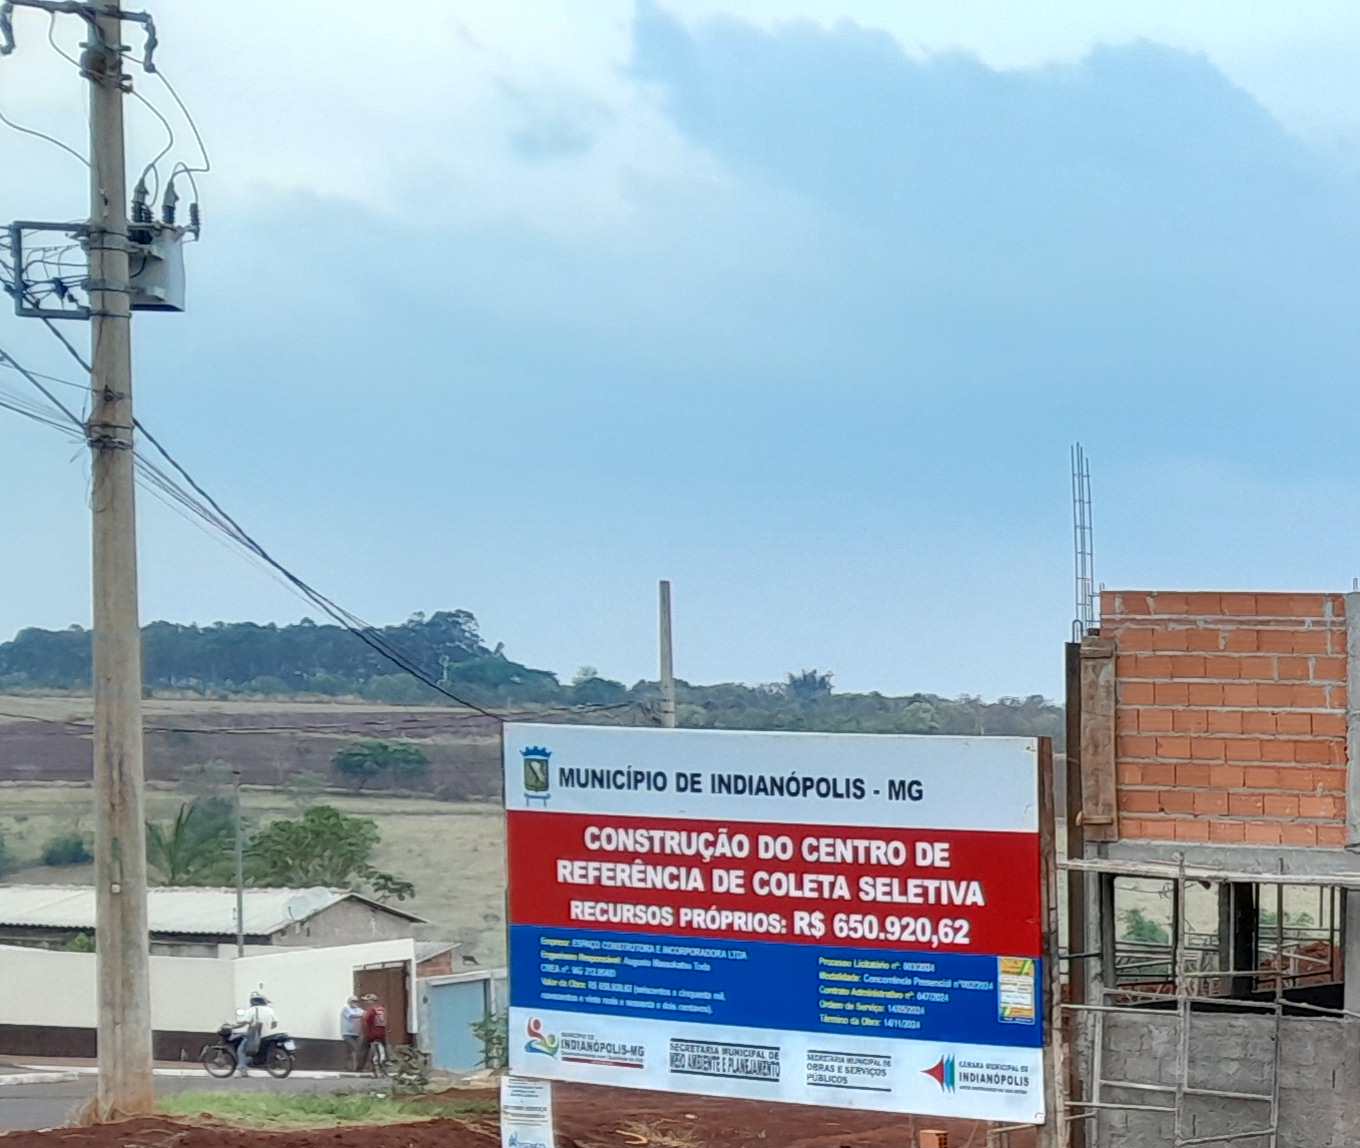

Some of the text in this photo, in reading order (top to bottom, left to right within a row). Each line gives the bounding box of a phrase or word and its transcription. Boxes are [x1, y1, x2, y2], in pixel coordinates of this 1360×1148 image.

[559, 765, 667, 792] MUNICÍPIO
[675, 772, 702, 793] DE
[710, 771, 865, 799] INDIANÓPOLIS
[888, 779, 923, 801] MG
[584, 826, 950, 867] CONSTRUÇÃO DO CENTRO DE
[557, 859, 985, 906] REFERÊNCIA DE COLETA SELETIVA
[570, 900, 970, 948] RECURSOS PRÓPRIOS: R$ 650.920,62
[670, 1043, 780, 1060] SECRETARIA MUNICIPAL DE
[806, 1063, 887, 1078] OBRAS E SERVIÇOS
[807, 1072, 848, 1084] PÚBLICOS
[959, 1072, 1030, 1087] INDIANÓPOLIS
